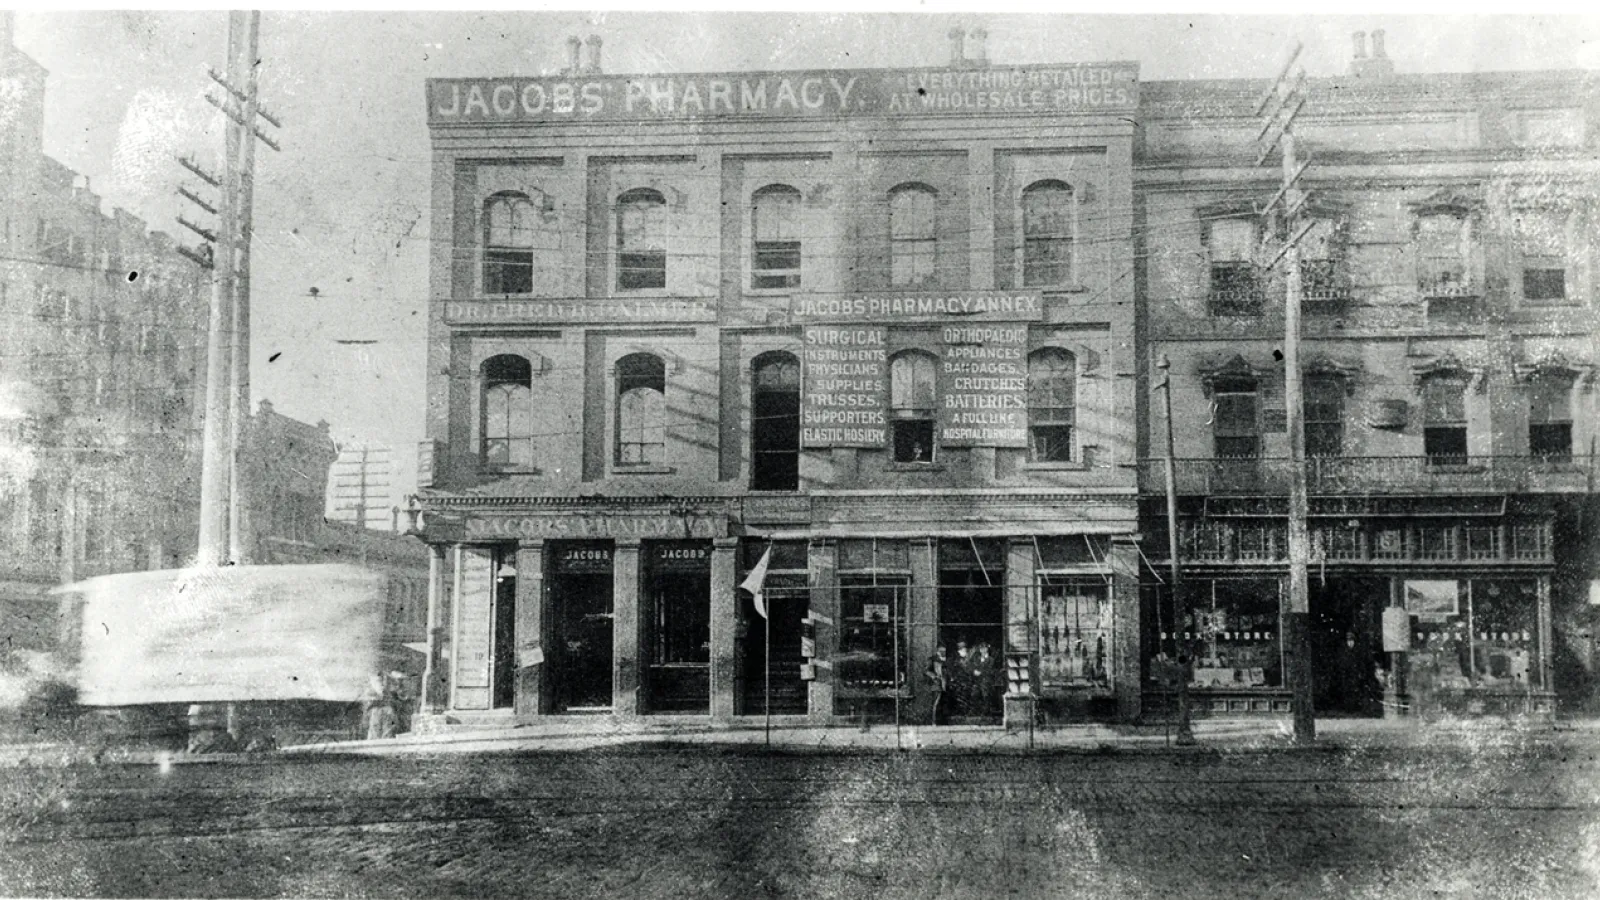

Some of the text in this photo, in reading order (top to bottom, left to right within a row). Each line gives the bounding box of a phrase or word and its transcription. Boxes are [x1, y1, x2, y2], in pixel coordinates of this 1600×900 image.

[906, 69, 1112, 89] EVERYTHING RETAILED
[888, 93, 912, 110] AT
[920, 90, 1044, 108] WHOLESALE
[870, 297, 971, 315] PHARMACY
[806, 330, 885, 345] SURGICAL
[944, 328, 1025, 343] ORTHOPAEDIC
[804, 350, 885, 361] INSTRUMENTS
[947, 348, 1020, 359] APPLIANCES
[952, 412, 1015, 424] A FULL LINE
[804, 428, 842, 442] ELASTIC
